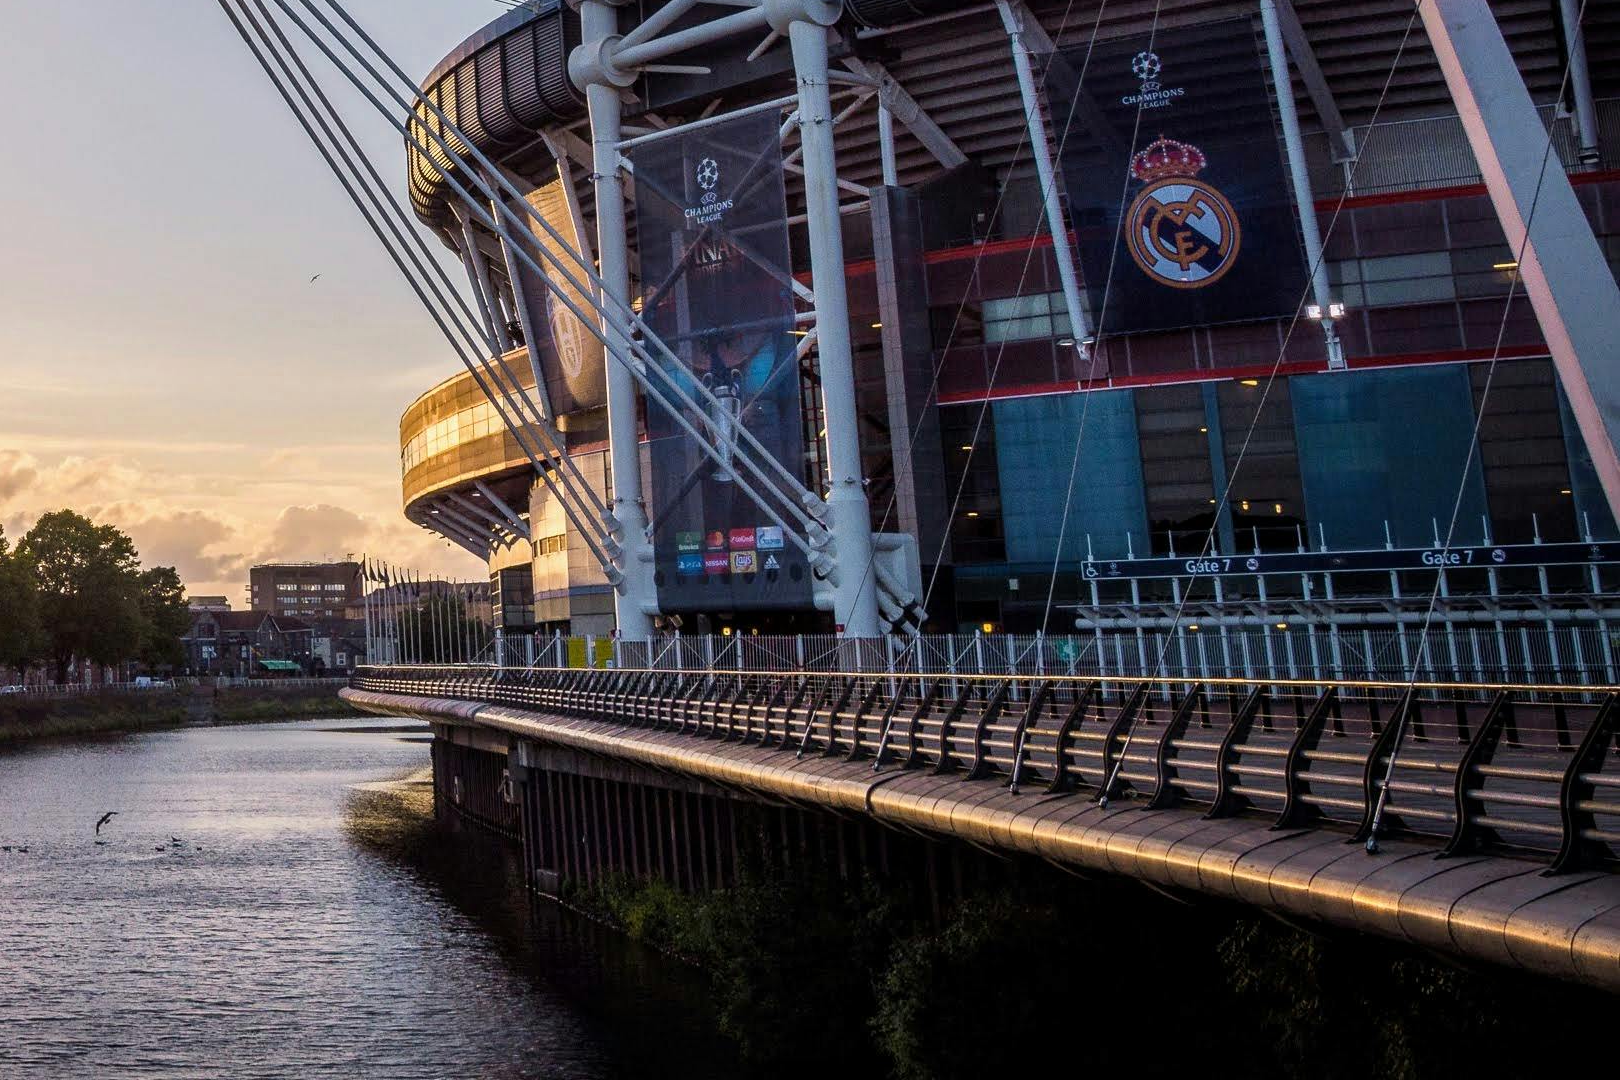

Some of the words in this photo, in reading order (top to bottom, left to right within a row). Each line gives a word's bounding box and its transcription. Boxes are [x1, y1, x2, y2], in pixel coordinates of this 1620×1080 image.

[1121, 87, 1184, 105] CHAMPIONS
[1140, 99, 1171, 110] LEAGUE
[684, 199, 733, 218] CHAMPIONS
[696, 212, 723, 224] LEAGUE
[705, 559, 728, 568] NISSAN
[1185, 559, 1220, 574] Gate
[1222, 558, 1232, 572] 7
[1421, 550, 1460, 566] Gate
[1463, 550, 1474, 564] 7
